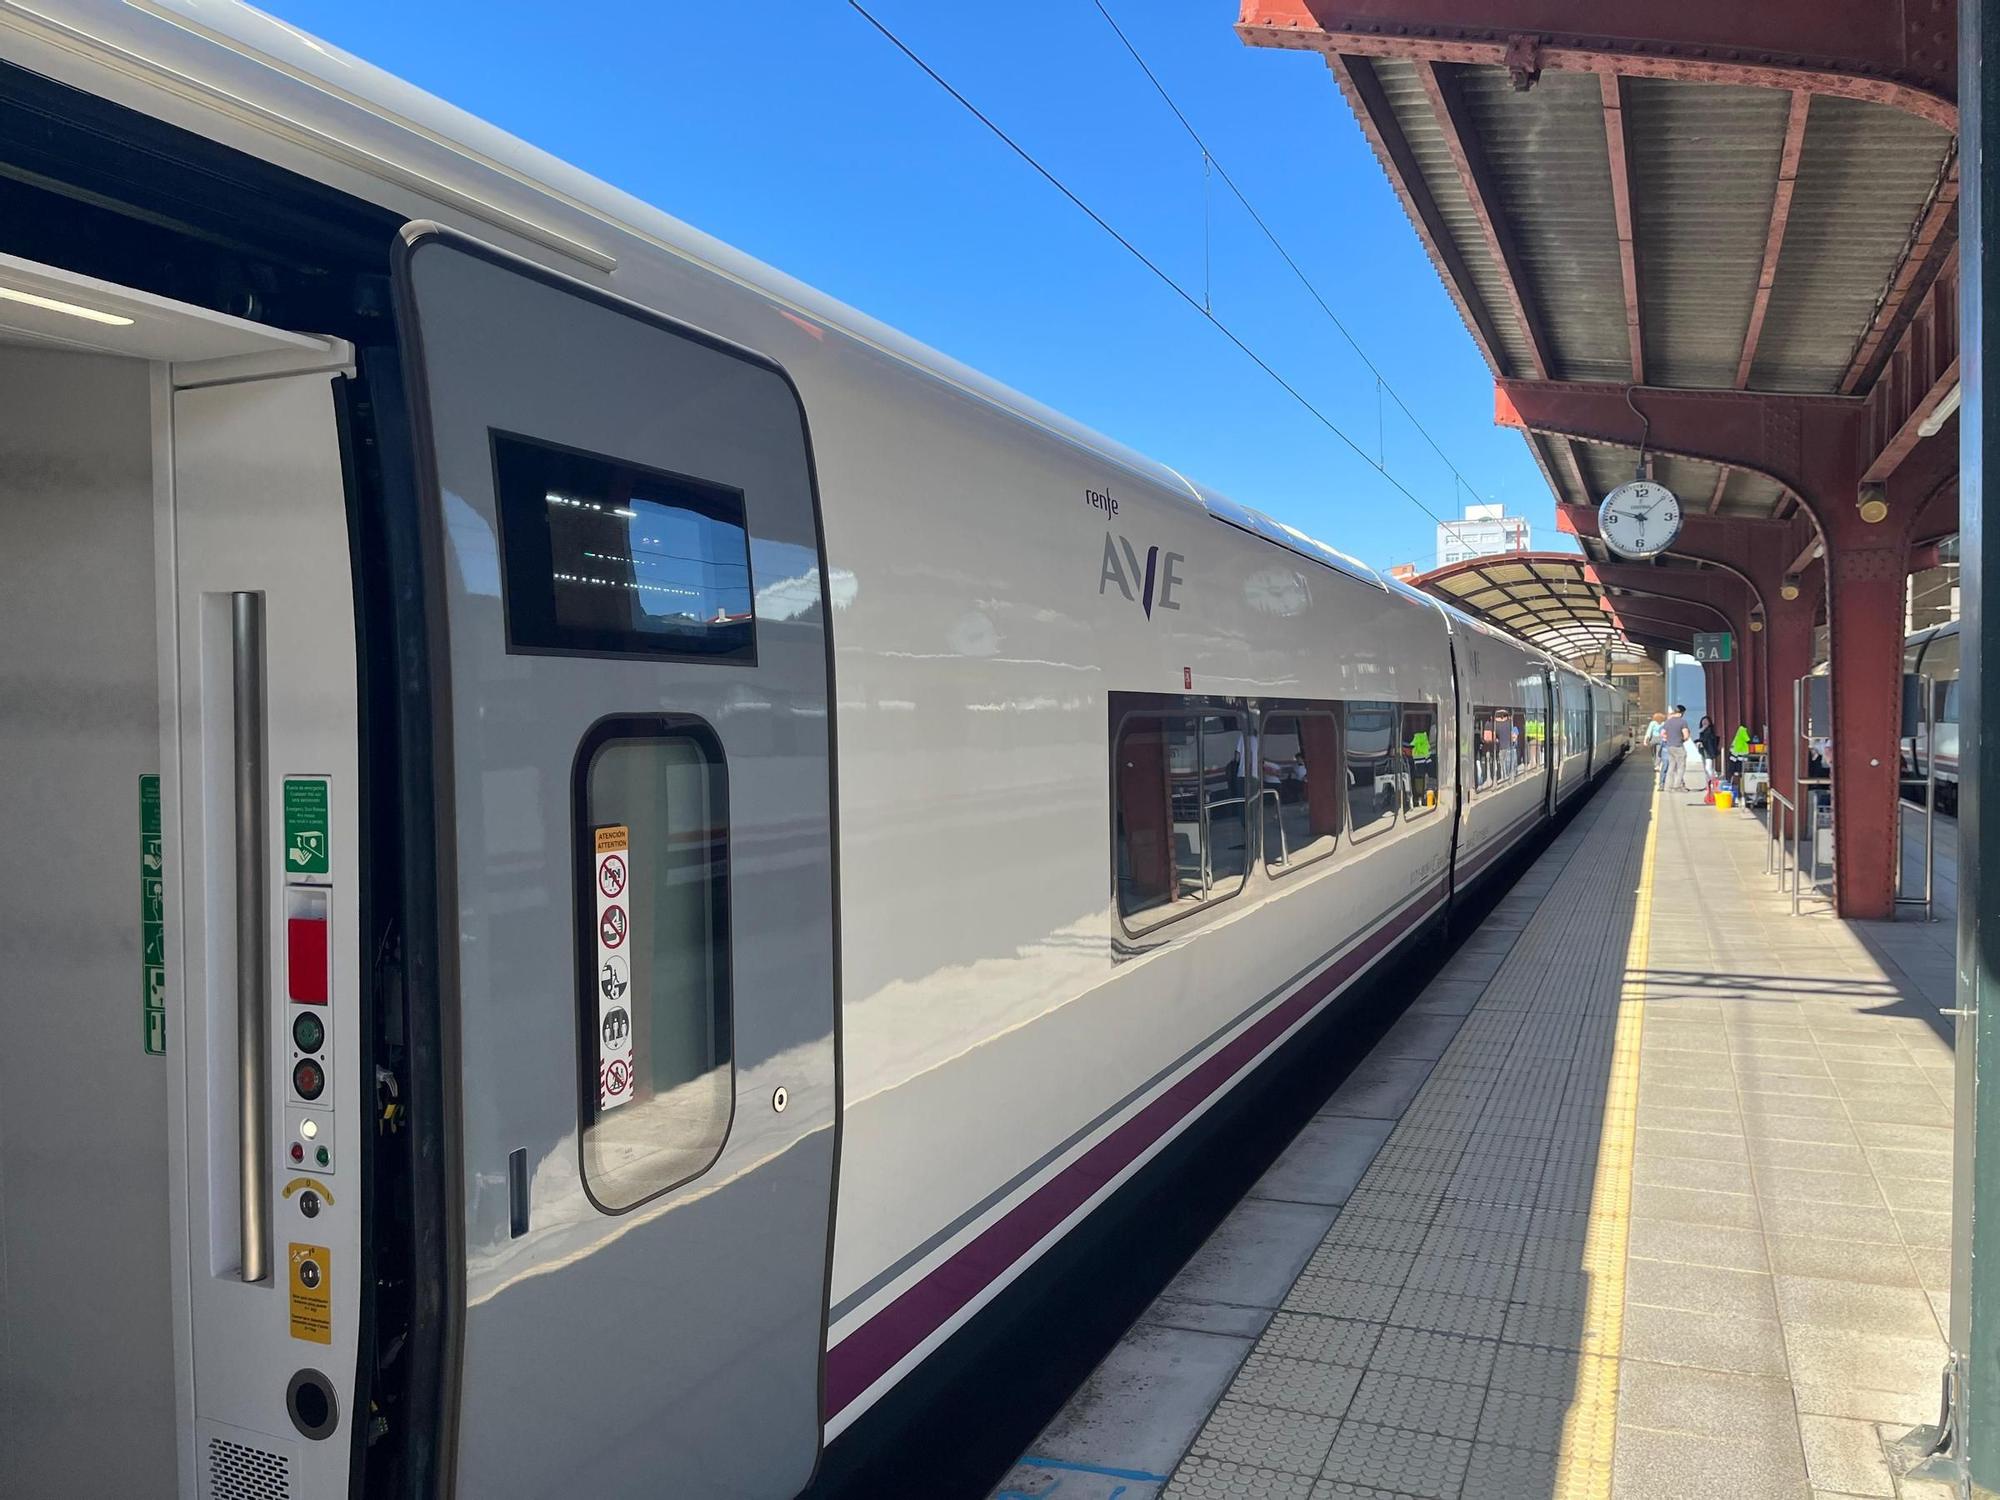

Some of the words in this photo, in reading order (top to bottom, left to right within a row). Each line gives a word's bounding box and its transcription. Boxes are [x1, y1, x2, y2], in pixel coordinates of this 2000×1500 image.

[1635, 489, 1649, 498] 12
[1086, 487, 1119, 521] renfe
[1609, 515, 1618, 524] 9
[1664, 512, 1673, 521] 3
[1635, 539, 1645, 548] 6
[1099, 531, 1185, 622] AVE
[1696, 646, 1705, 659] 6
[1709, 646, 1719, 659] A
[599, 831, 626, 840] ATENCIÓN
[598, 840, 626, 849] ATTENTION
